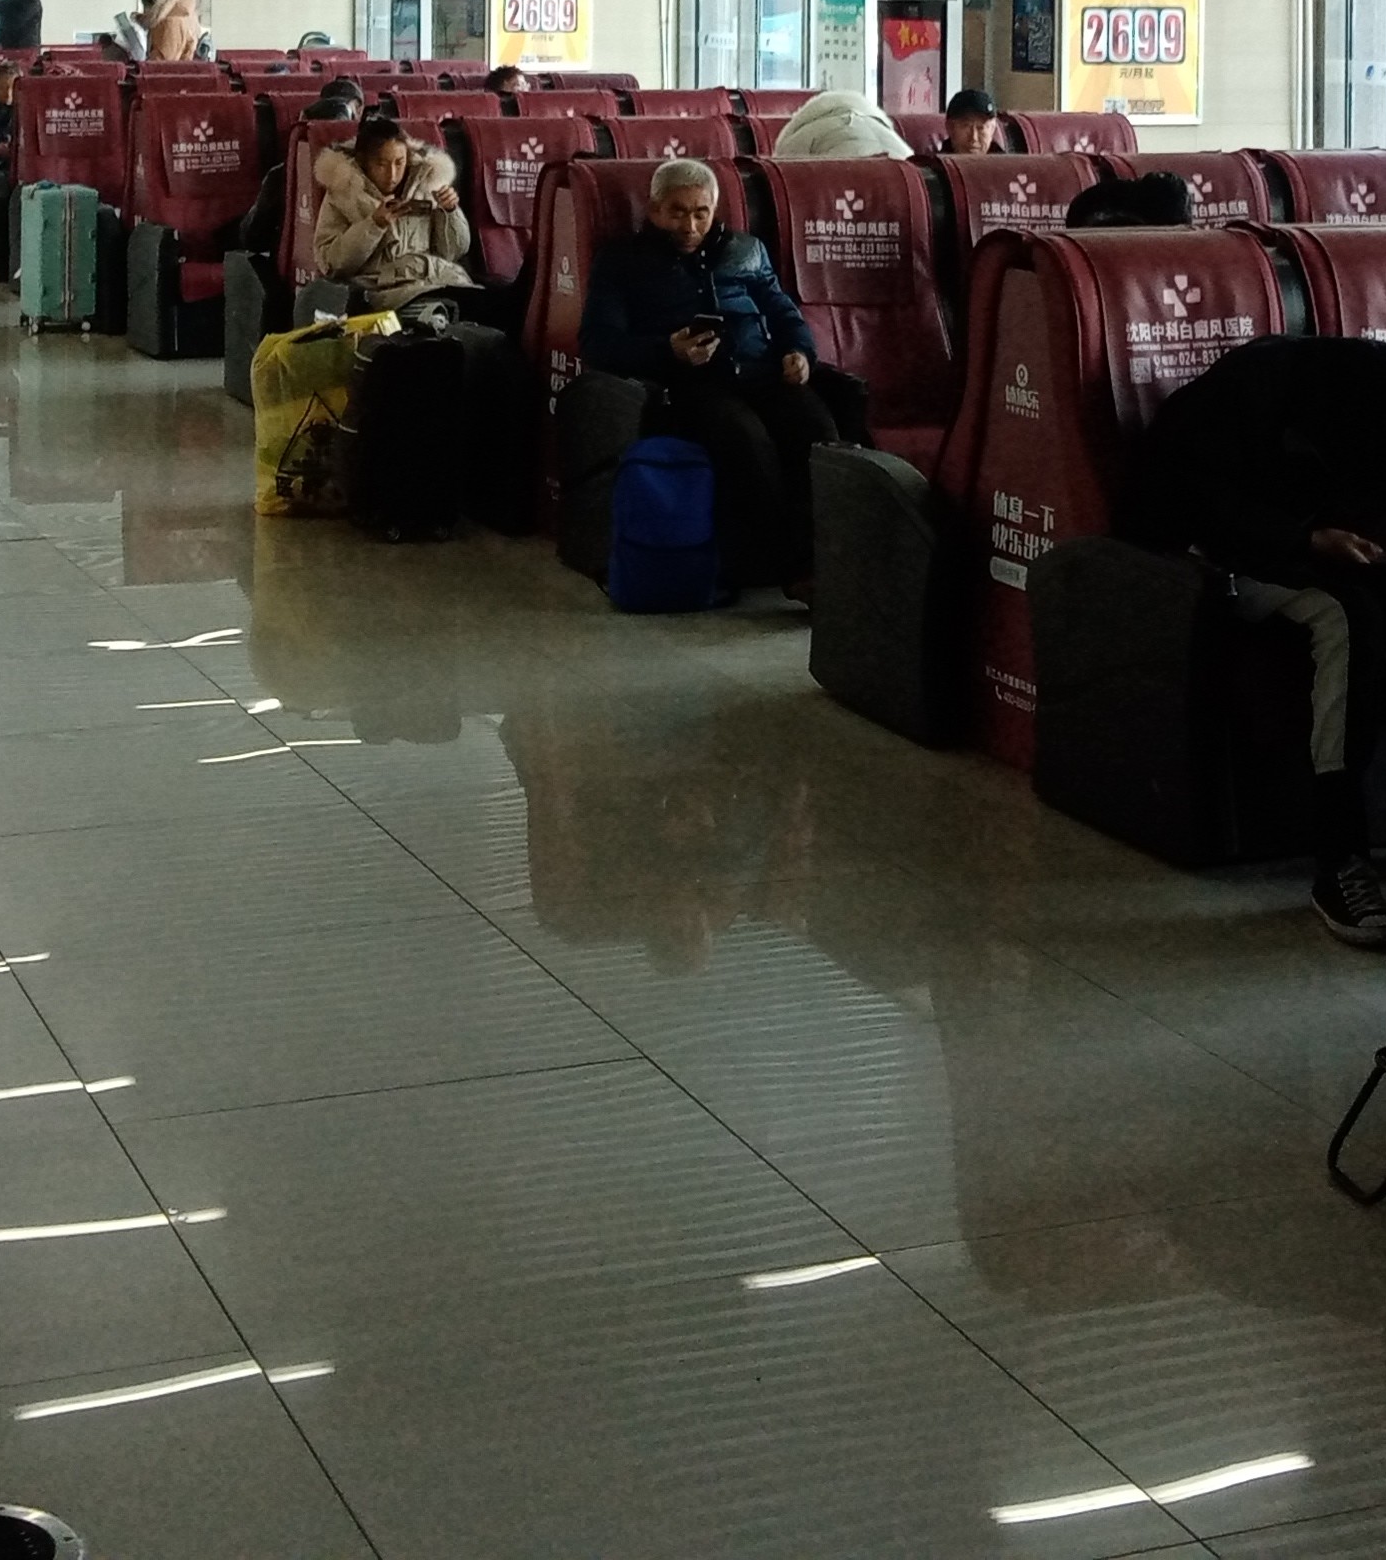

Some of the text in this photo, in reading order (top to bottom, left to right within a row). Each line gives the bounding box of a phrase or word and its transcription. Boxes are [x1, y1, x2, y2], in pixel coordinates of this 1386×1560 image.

[1085, 12, 1184, 61] 2699
[1126, 315, 1255, 344] 沈阳中科白癜风医院
[992, 488, 1056, 534] 休息一下
